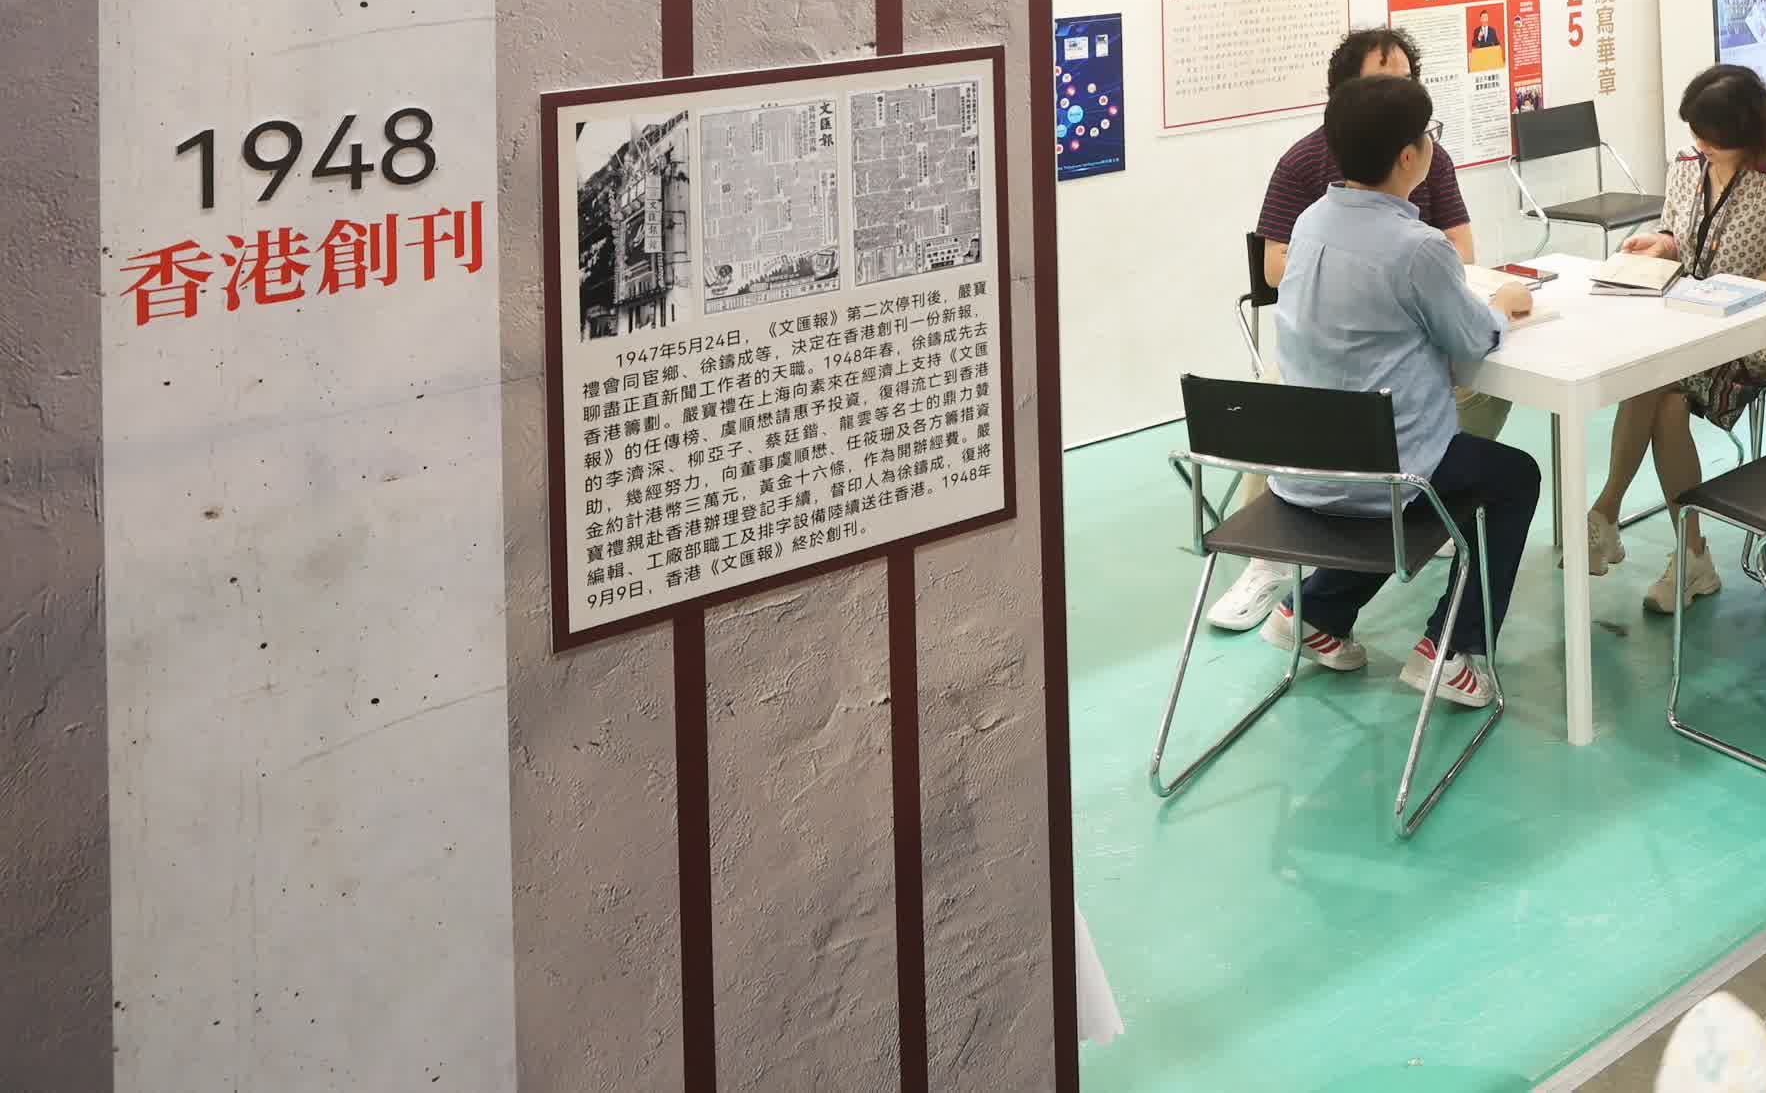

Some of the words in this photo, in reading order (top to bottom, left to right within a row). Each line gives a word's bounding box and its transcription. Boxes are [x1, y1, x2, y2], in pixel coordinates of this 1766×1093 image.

[175, 106, 438, 211] 1948
[117, 199, 486, 327] 香港創刊
